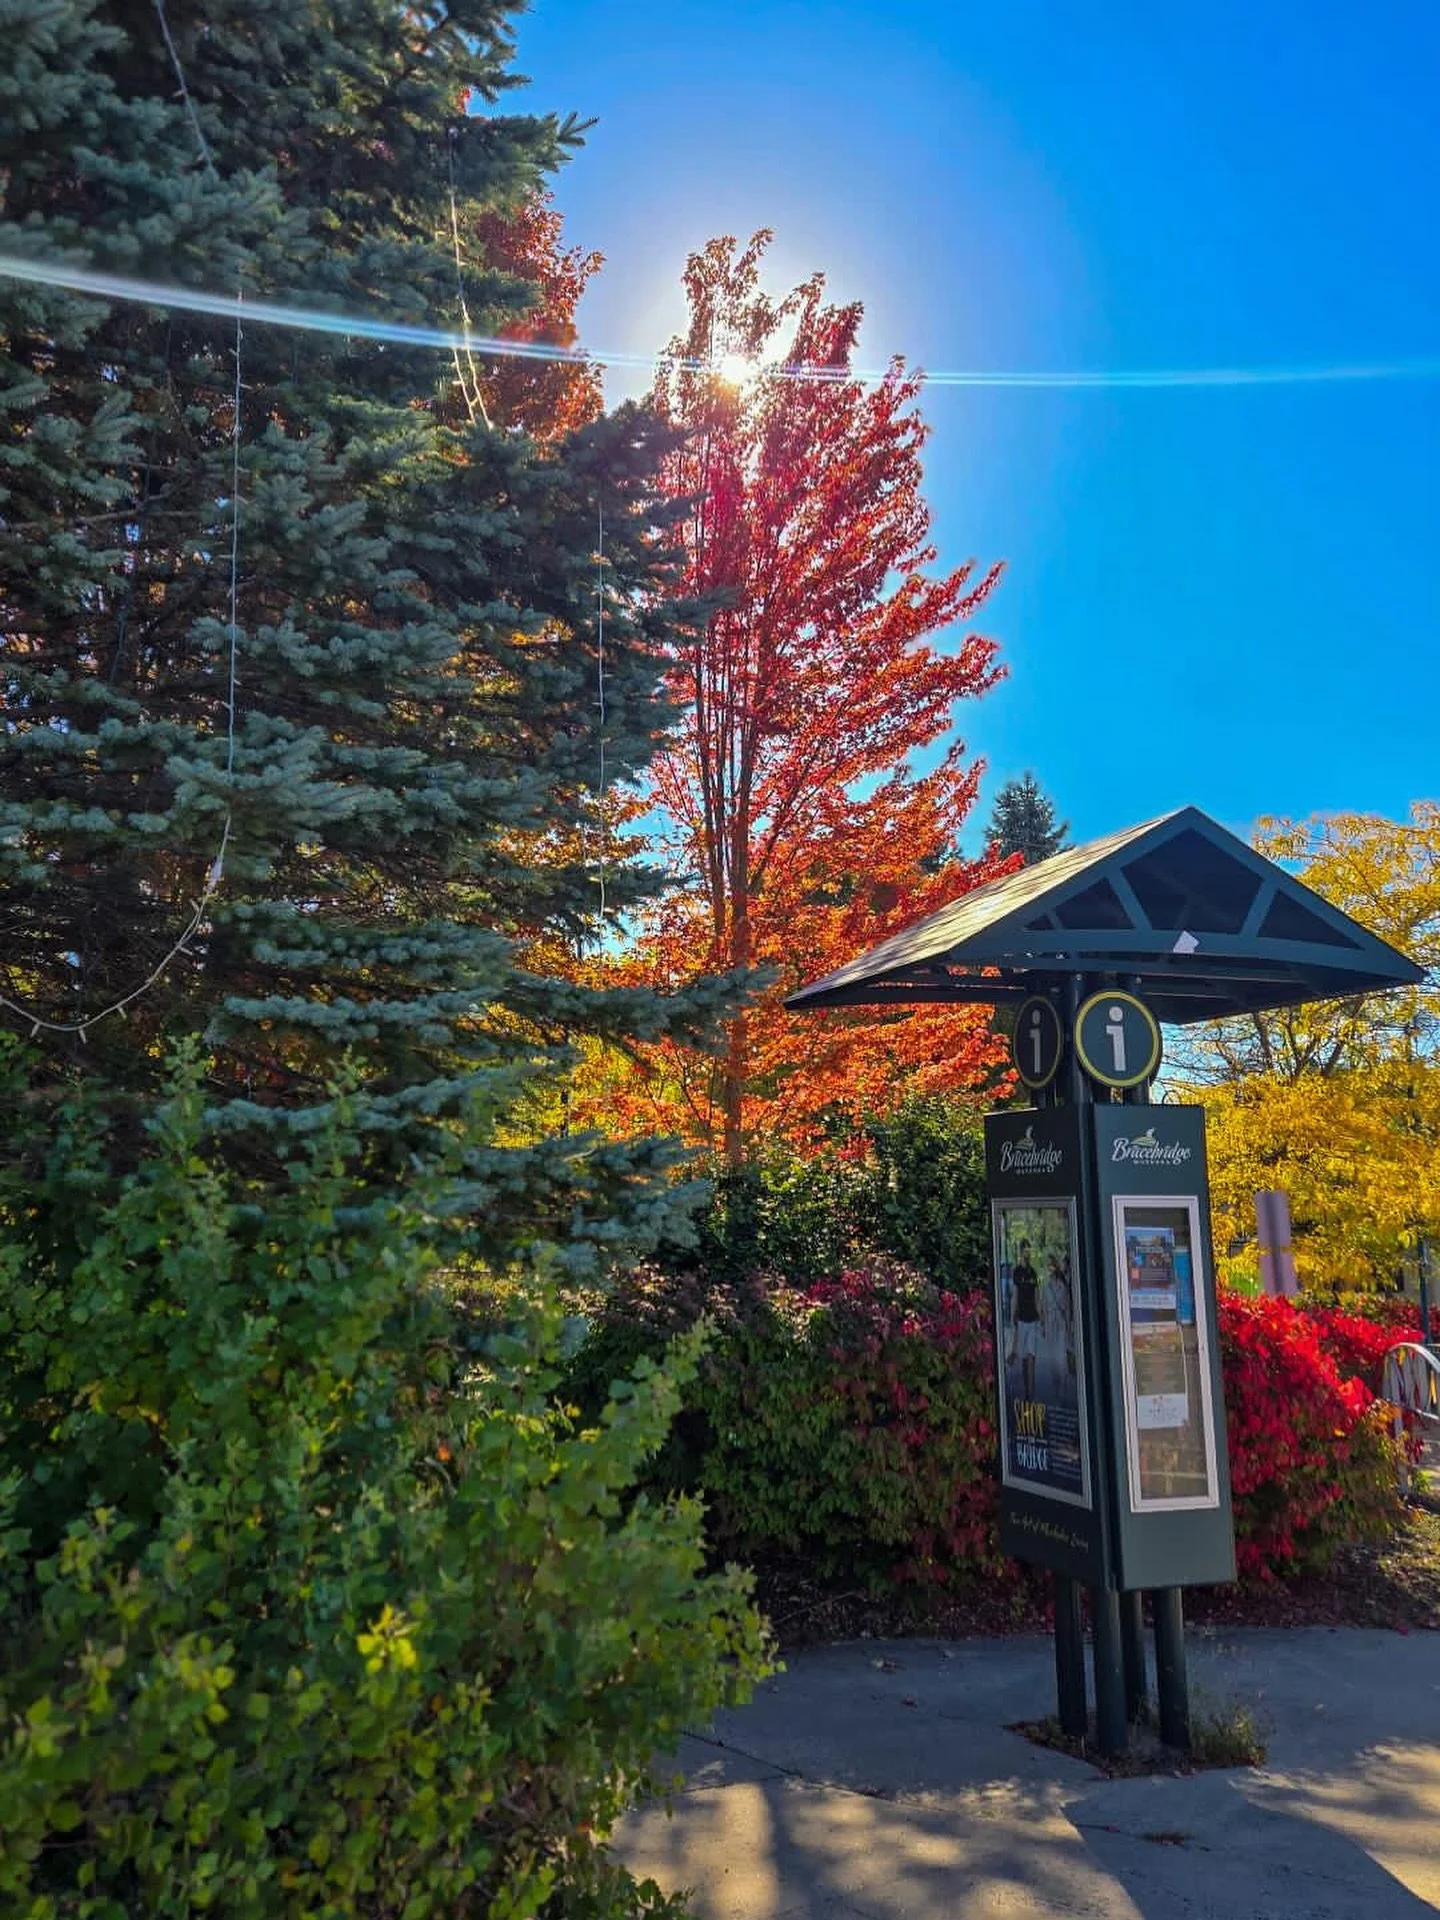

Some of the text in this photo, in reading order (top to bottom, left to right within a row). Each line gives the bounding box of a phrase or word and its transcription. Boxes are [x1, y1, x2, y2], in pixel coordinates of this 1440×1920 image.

[1106, 1005, 1127, 1072] i
[1000, 1139, 1063, 1174] Bracebridge
[1111, 1137, 1192, 1166] Bracebridge
[1014, 1398, 1046, 1438] SHOP
